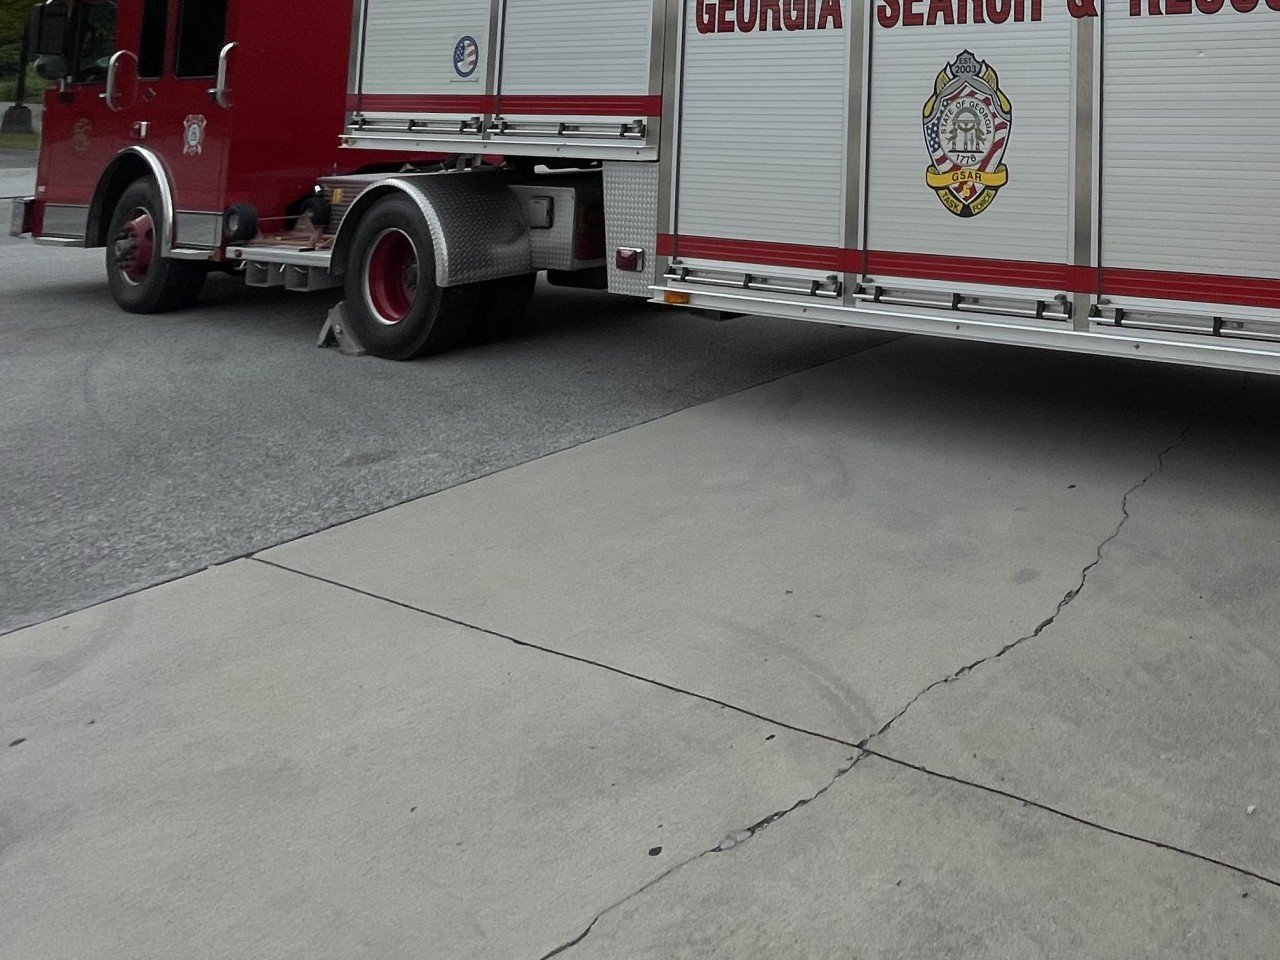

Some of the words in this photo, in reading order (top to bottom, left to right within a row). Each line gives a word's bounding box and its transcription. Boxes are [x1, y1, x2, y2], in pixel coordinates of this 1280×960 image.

[959, 57, 975, 65] EST.
[955, 64, 977, 74] 2003
[941, 108, 954, 135] STATE
[955, 100, 966, 109] OF
[969, 100, 992, 135] GEORGIA
[951, 171, 982, 182] GSAR
[942, 190, 960, 211] TASK
[972, 190, 993, 212] FORCE
